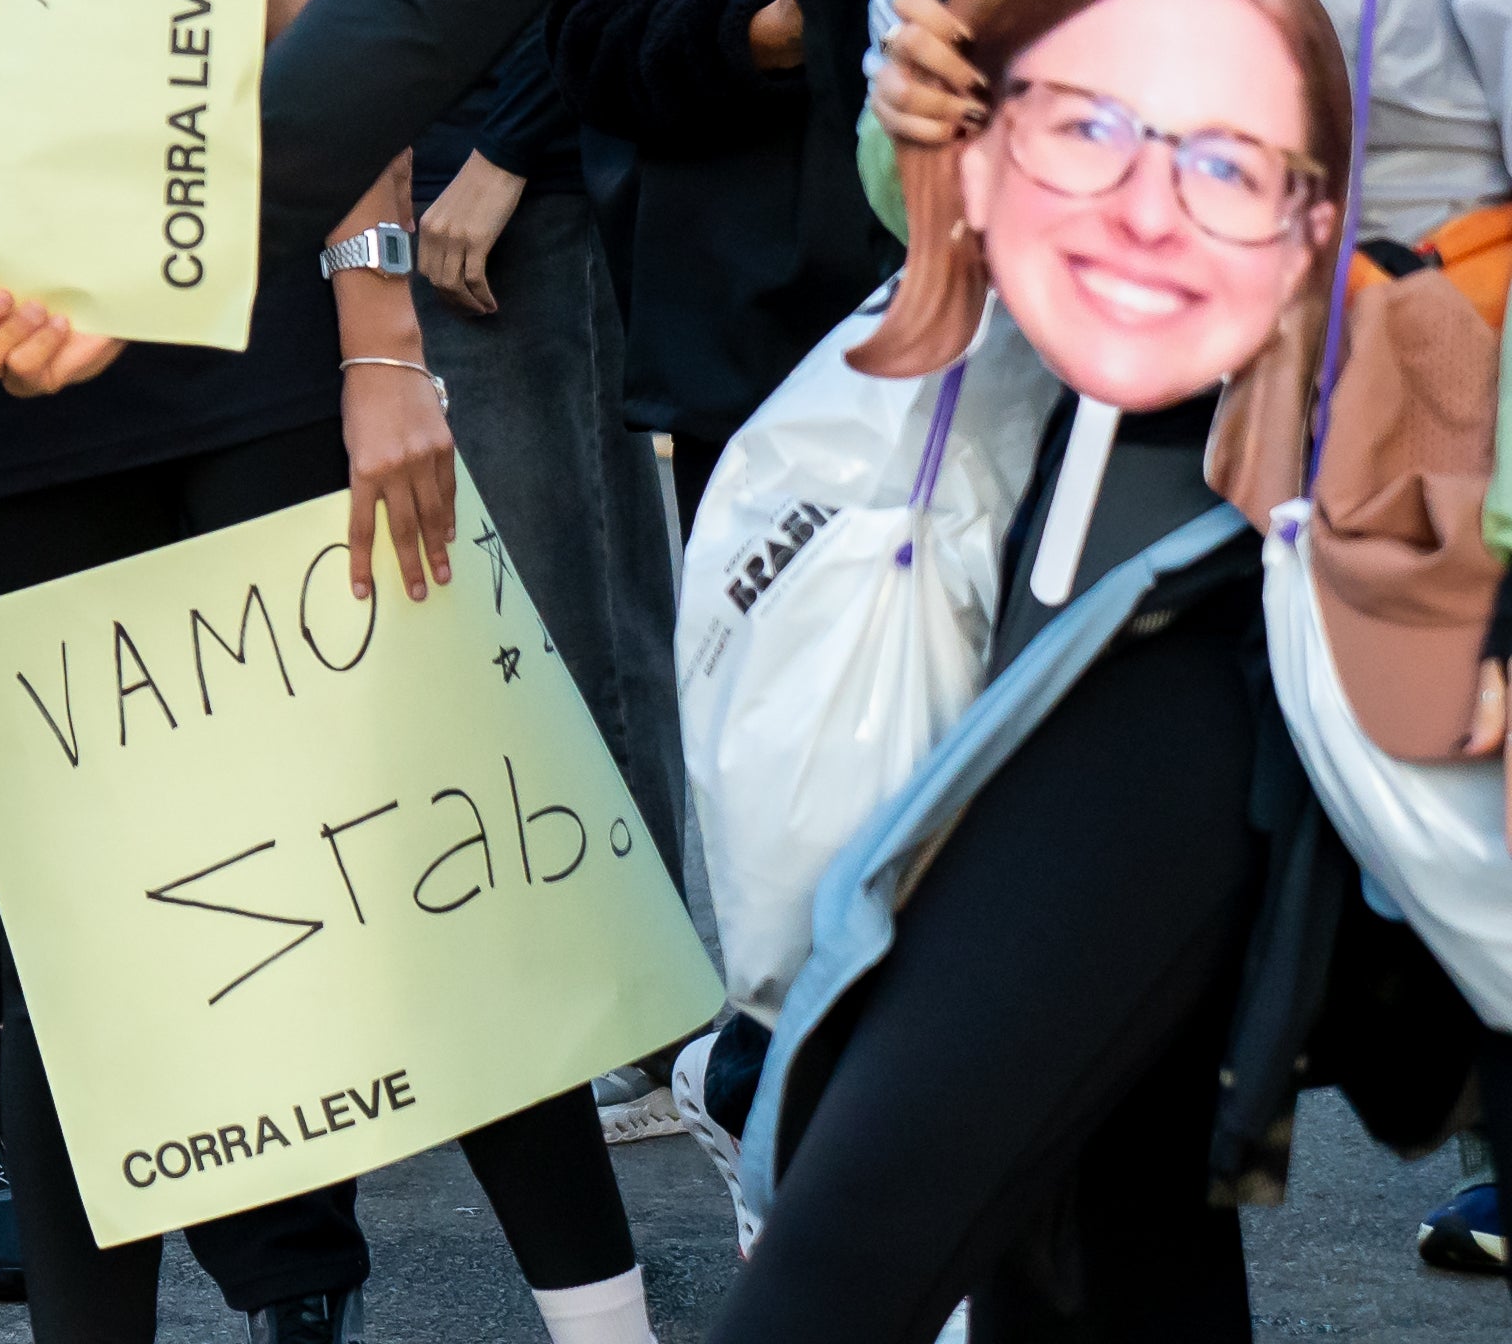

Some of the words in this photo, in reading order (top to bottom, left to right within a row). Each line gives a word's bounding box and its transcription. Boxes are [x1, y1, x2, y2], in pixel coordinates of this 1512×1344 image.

[162, 101, 210, 291] CORRA
[122, 1113, 290, 1190] CORRA
[293, 1069, 419, 1143] LEVE
